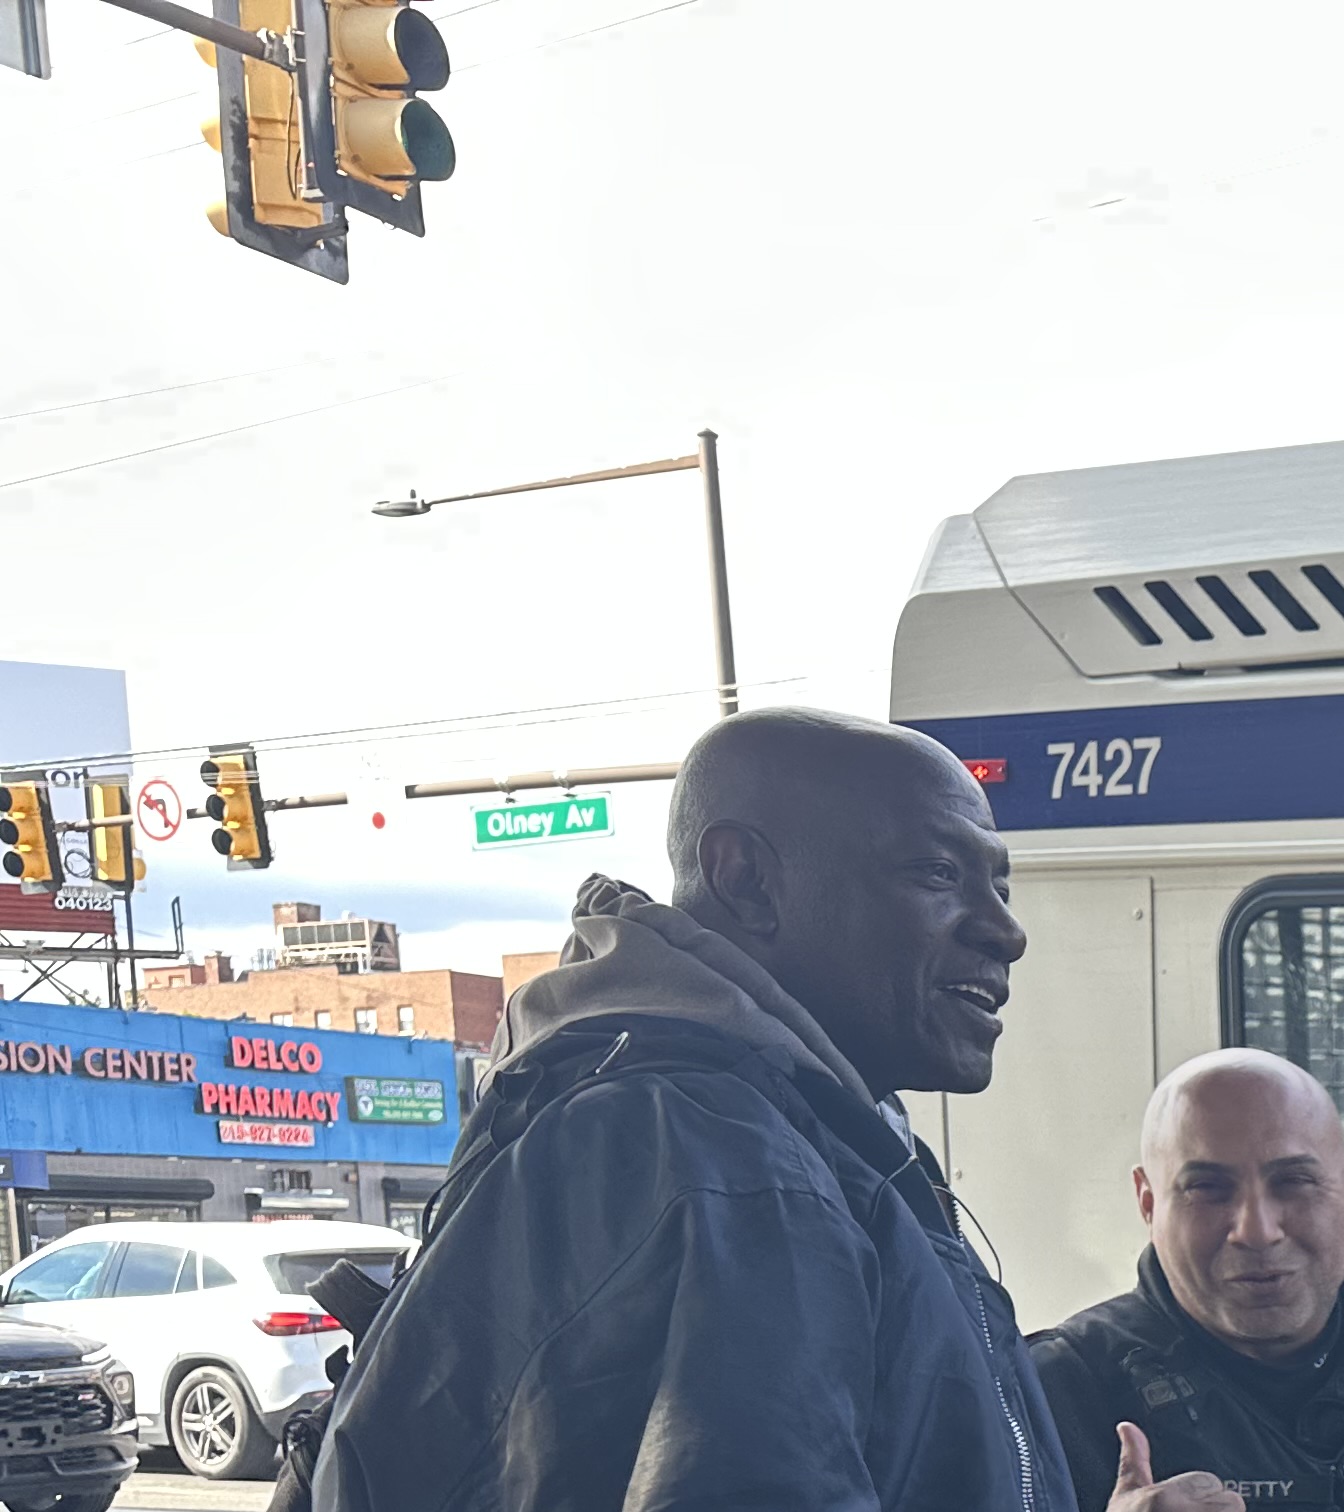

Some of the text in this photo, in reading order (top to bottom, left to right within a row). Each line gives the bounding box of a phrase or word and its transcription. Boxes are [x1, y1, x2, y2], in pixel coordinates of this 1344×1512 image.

[1047, 737, 1161, 799] 7427
[487, 804, 596, 837] Olney Av
[54, 895, 113, 912] 040123
[84, 1047, 198, 1083] CENTER
[232, 1036, 323, 1074] DELCO
[201, 1081, 341, 1122] PHARMACY
